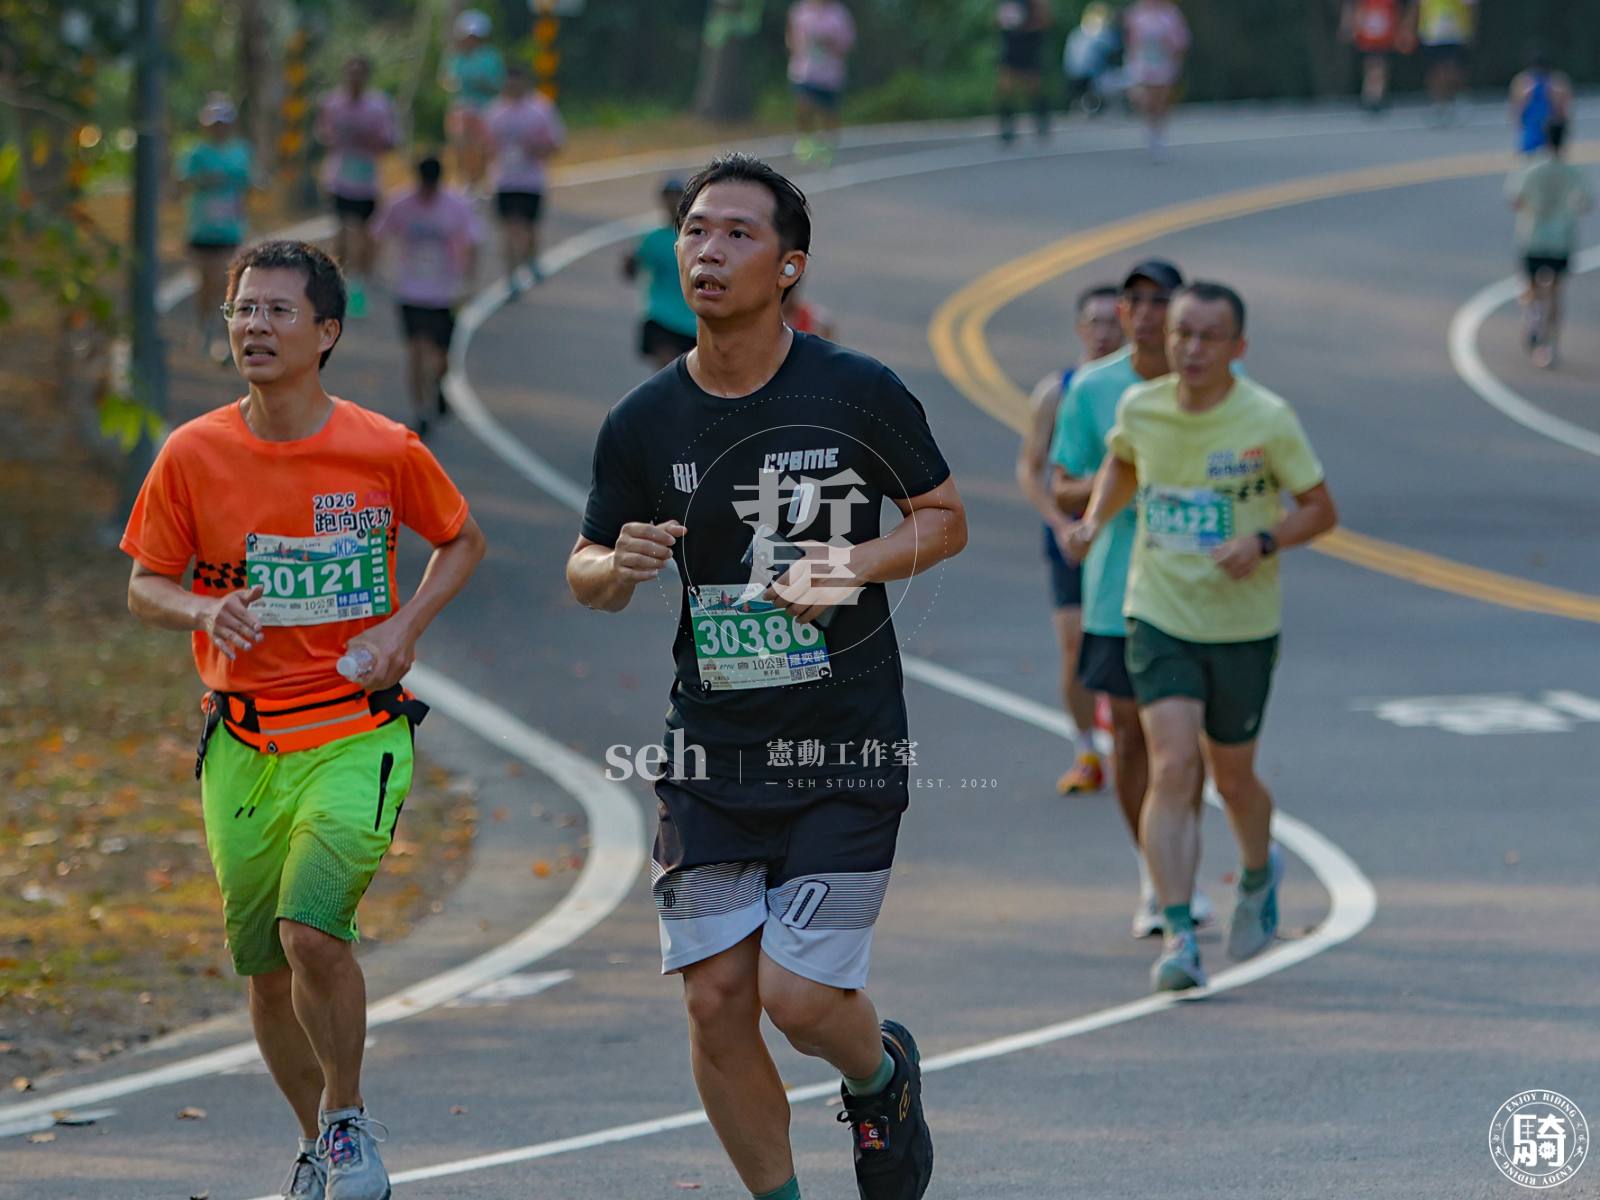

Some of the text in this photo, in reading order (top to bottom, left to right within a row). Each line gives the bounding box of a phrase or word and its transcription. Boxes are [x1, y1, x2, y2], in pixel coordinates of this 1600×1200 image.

[314, 493, 356, 510] 2026
[314, 507, 392, 538] 跑向成功
[251, 560, 362, 596] 30121
[698, 615, 819, 655] 30386
[753, 656, 786, 671] 10公里
